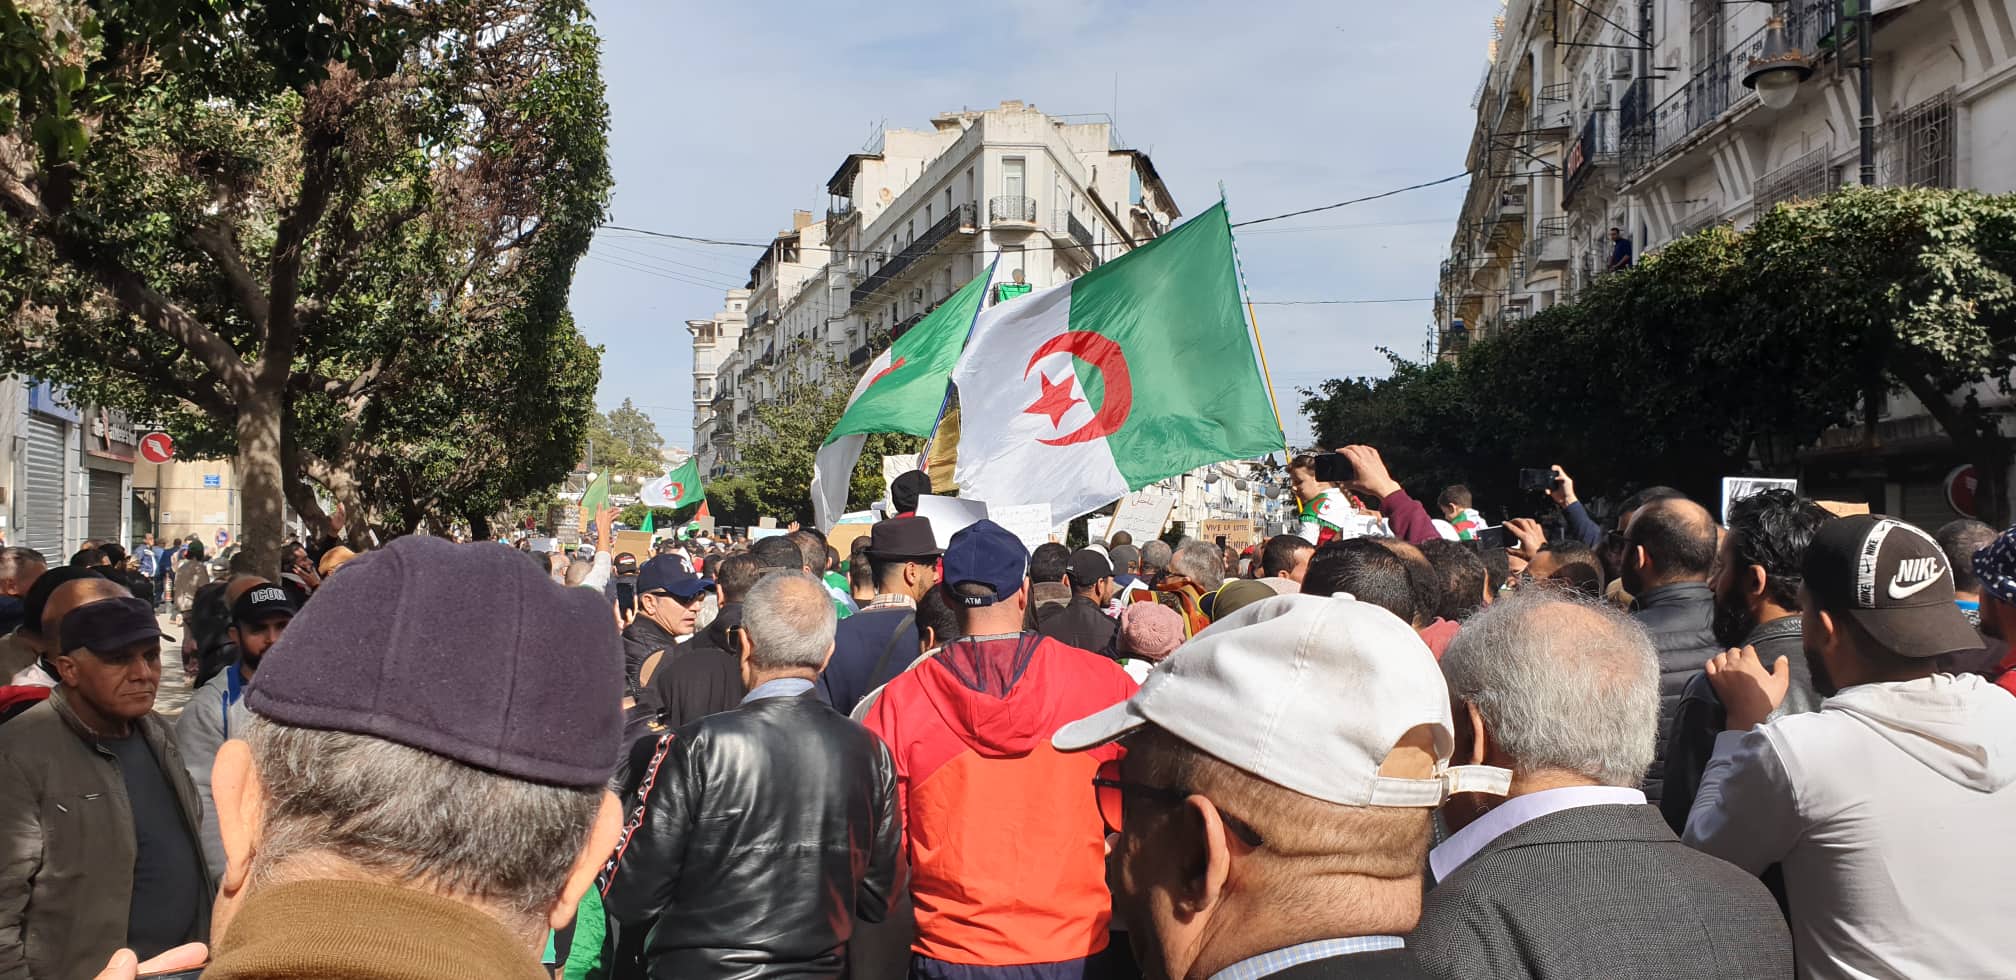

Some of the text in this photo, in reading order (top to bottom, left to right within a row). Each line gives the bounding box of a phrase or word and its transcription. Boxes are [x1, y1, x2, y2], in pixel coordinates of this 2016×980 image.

[1206, 523, 1221, 531] VIVE
[1865, 538, 1880, 556] NIKE
[1896, 556, 1938, 583] NIKE
[250, 587, 287, 604] ICON
[965, 597, 982, 605] ATM
